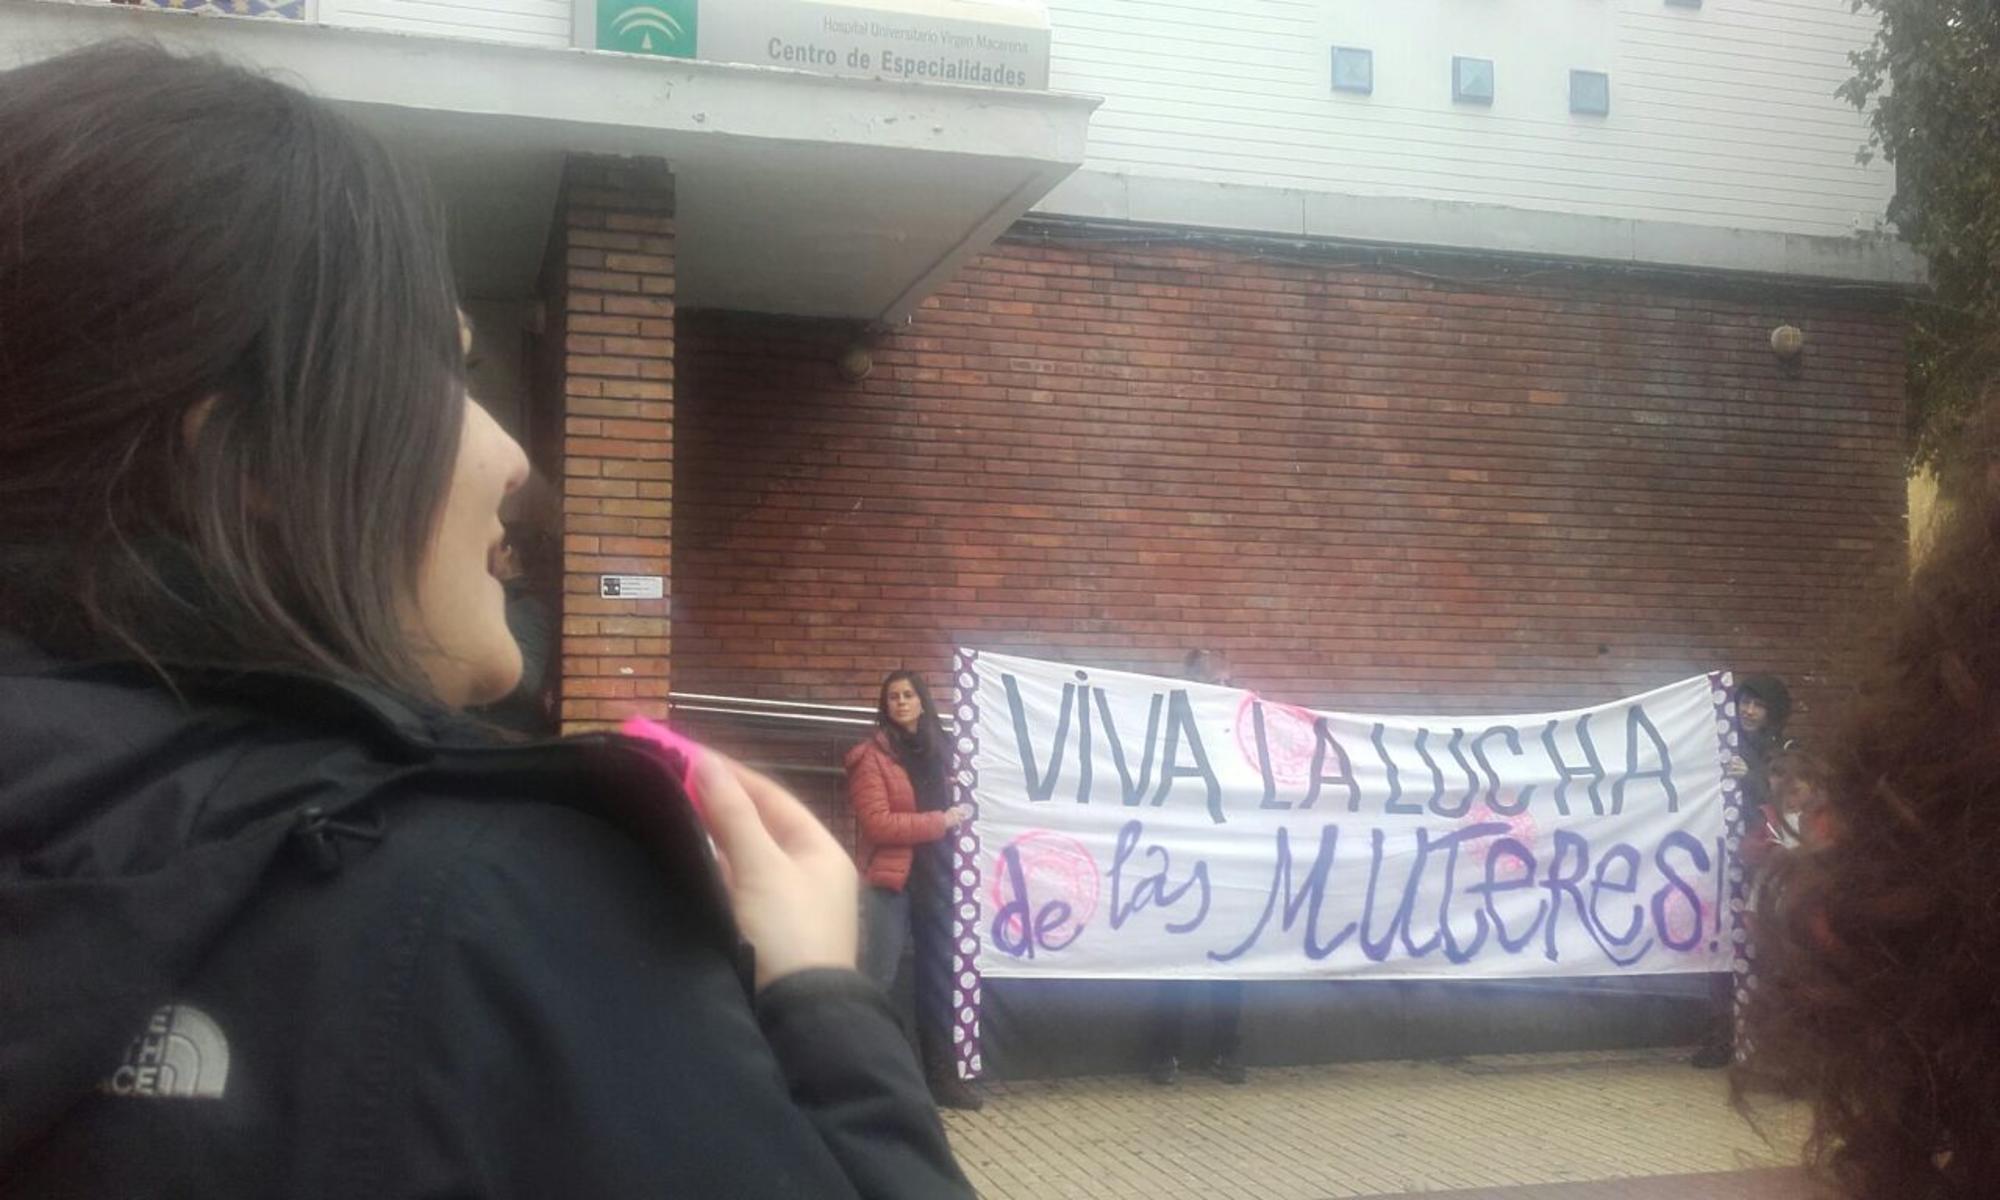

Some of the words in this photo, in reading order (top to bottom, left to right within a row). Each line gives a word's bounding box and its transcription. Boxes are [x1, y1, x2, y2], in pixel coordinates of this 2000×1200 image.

[768, 37, 836, 65] Centro
[847, 46, 870, 69] de
[881, 50, 1026, 86] Especialidades
[823, 15, 868, 35] Hospital
[871, 22, 938, 44] Universitario
[940, 30, 974, 49] Virgen
[976, 34, 1029, 54] Macarena
[1252, 701, 1361, 813] LA
[1371, 704, 1679, 818] LUCHA
[991, 844, 1084, 959] de
[1107, 819, 1211, 934] las
